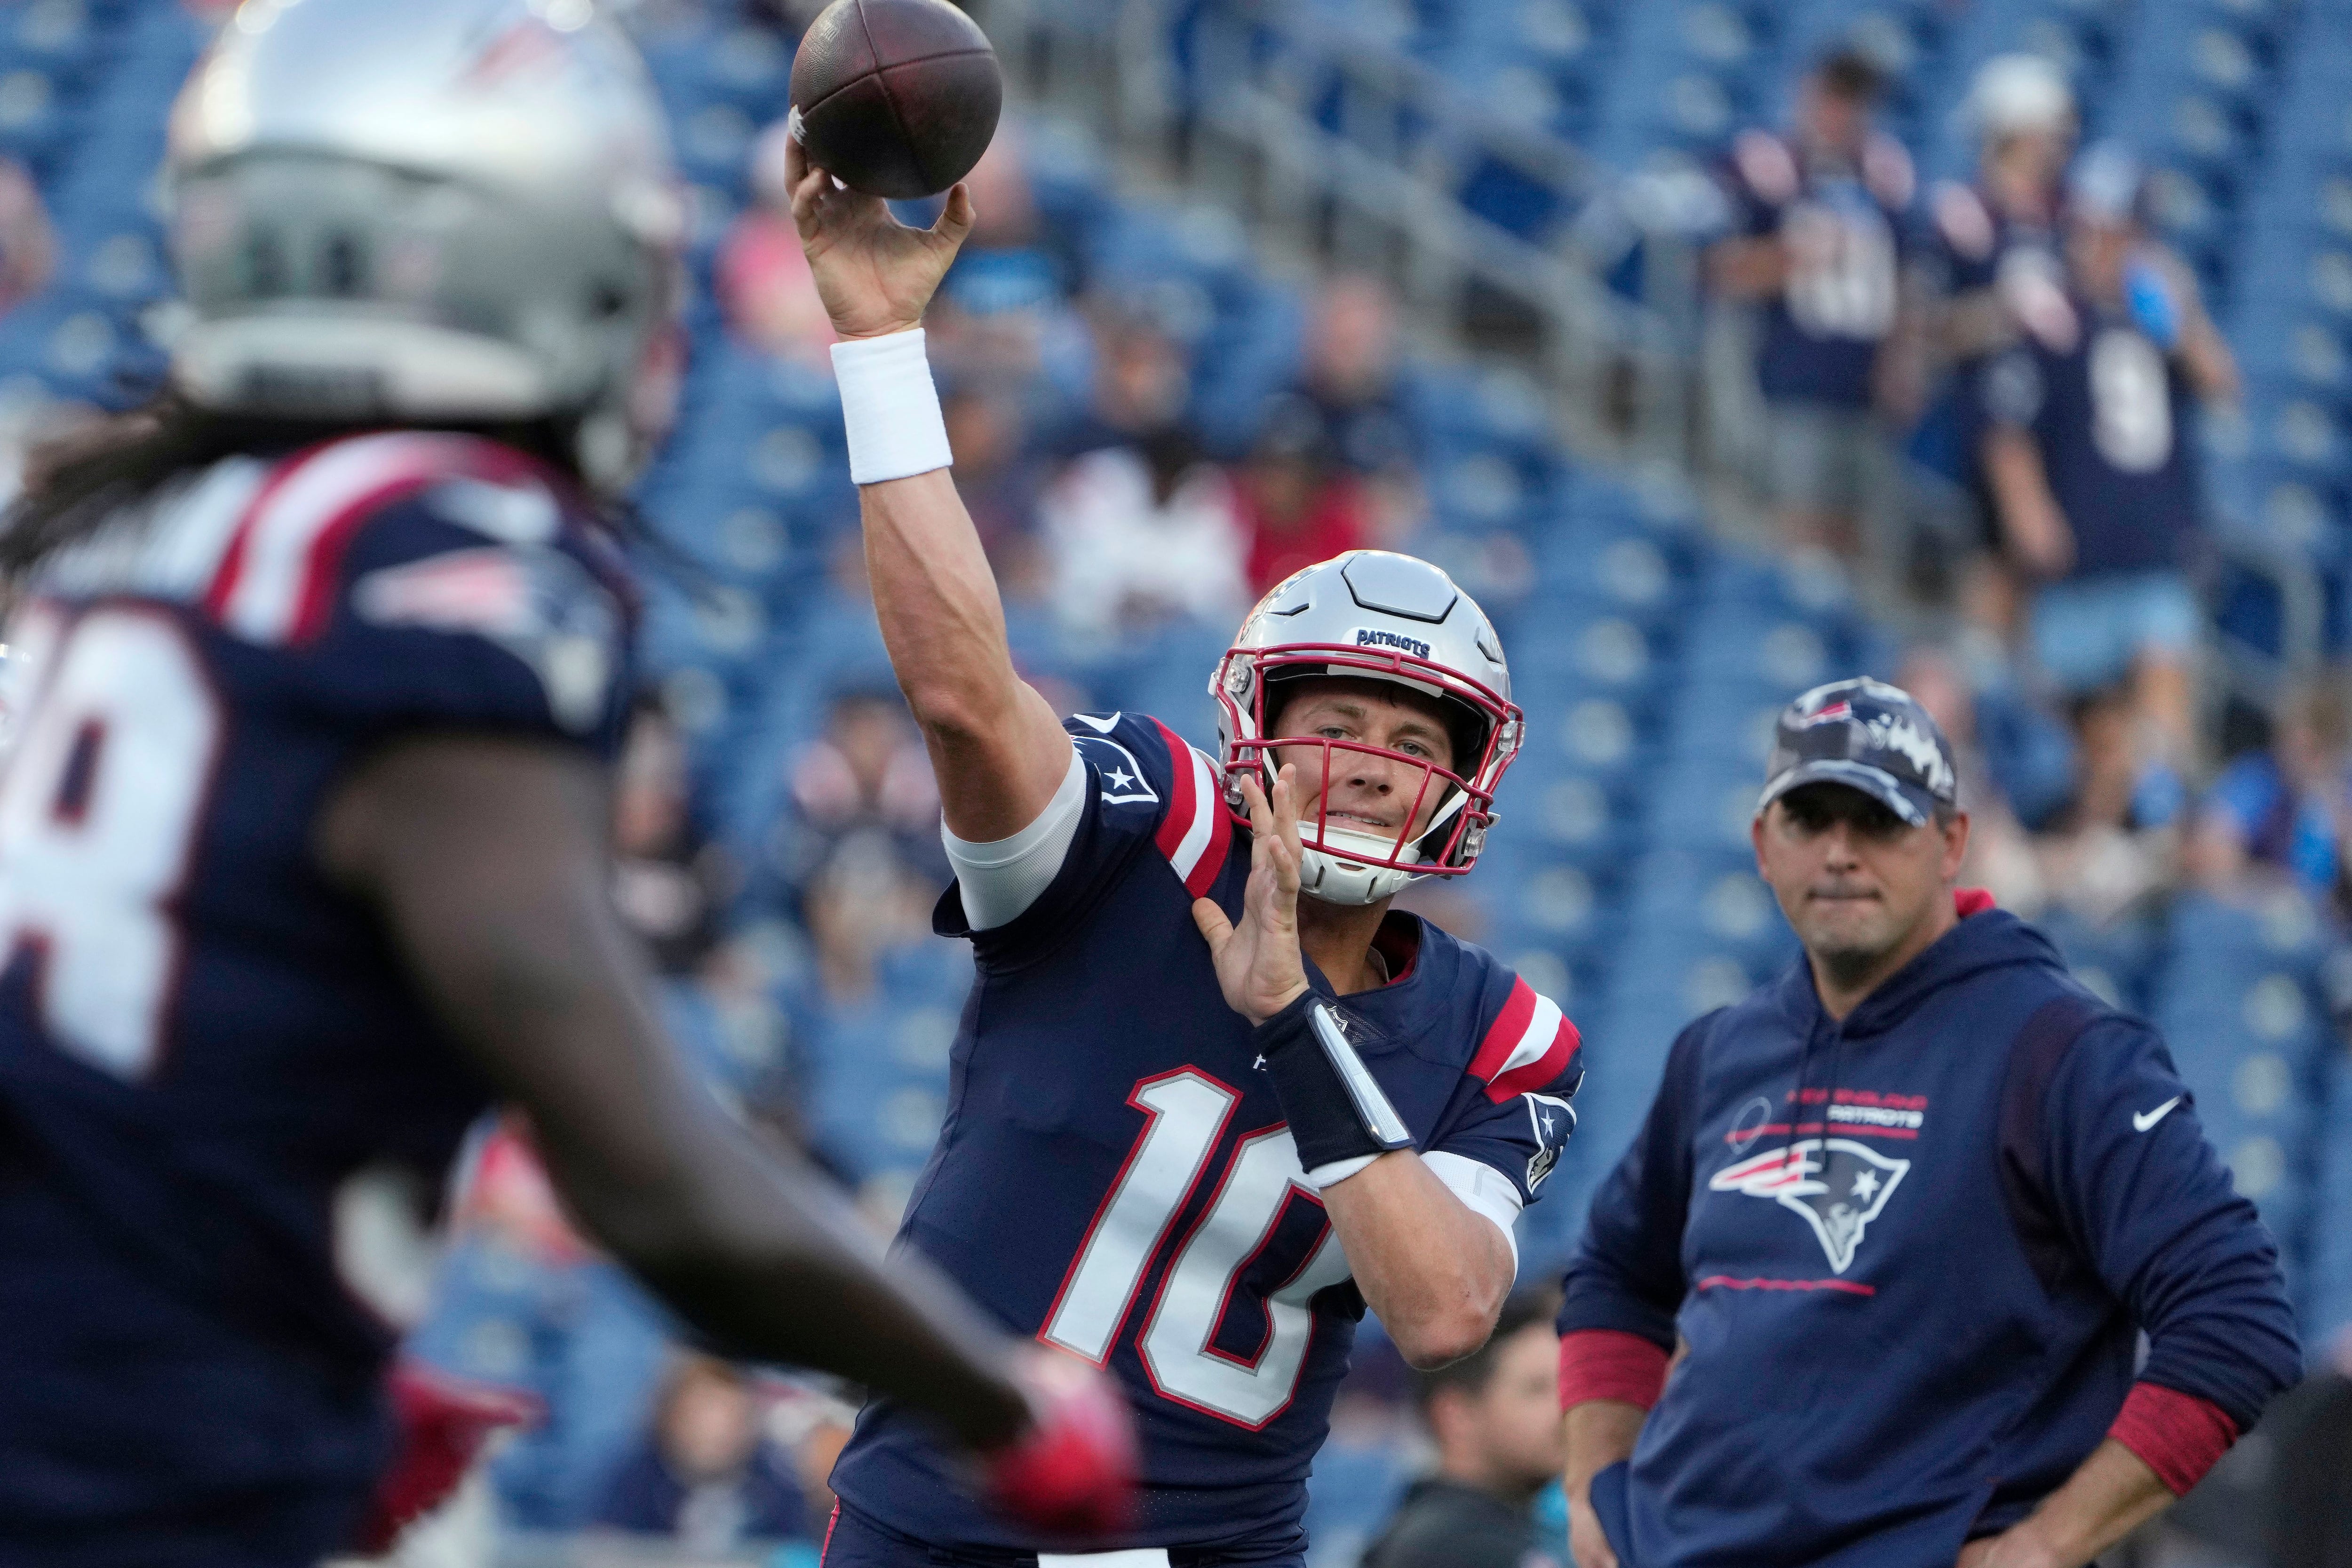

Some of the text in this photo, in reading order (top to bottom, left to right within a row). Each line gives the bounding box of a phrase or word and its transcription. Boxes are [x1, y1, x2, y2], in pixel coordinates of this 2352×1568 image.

[1357, 629, 1430, 660] PATRIOTS
[0, 597, 228, 1064] 8
[1036, 1064, 1354, 1432] 10
